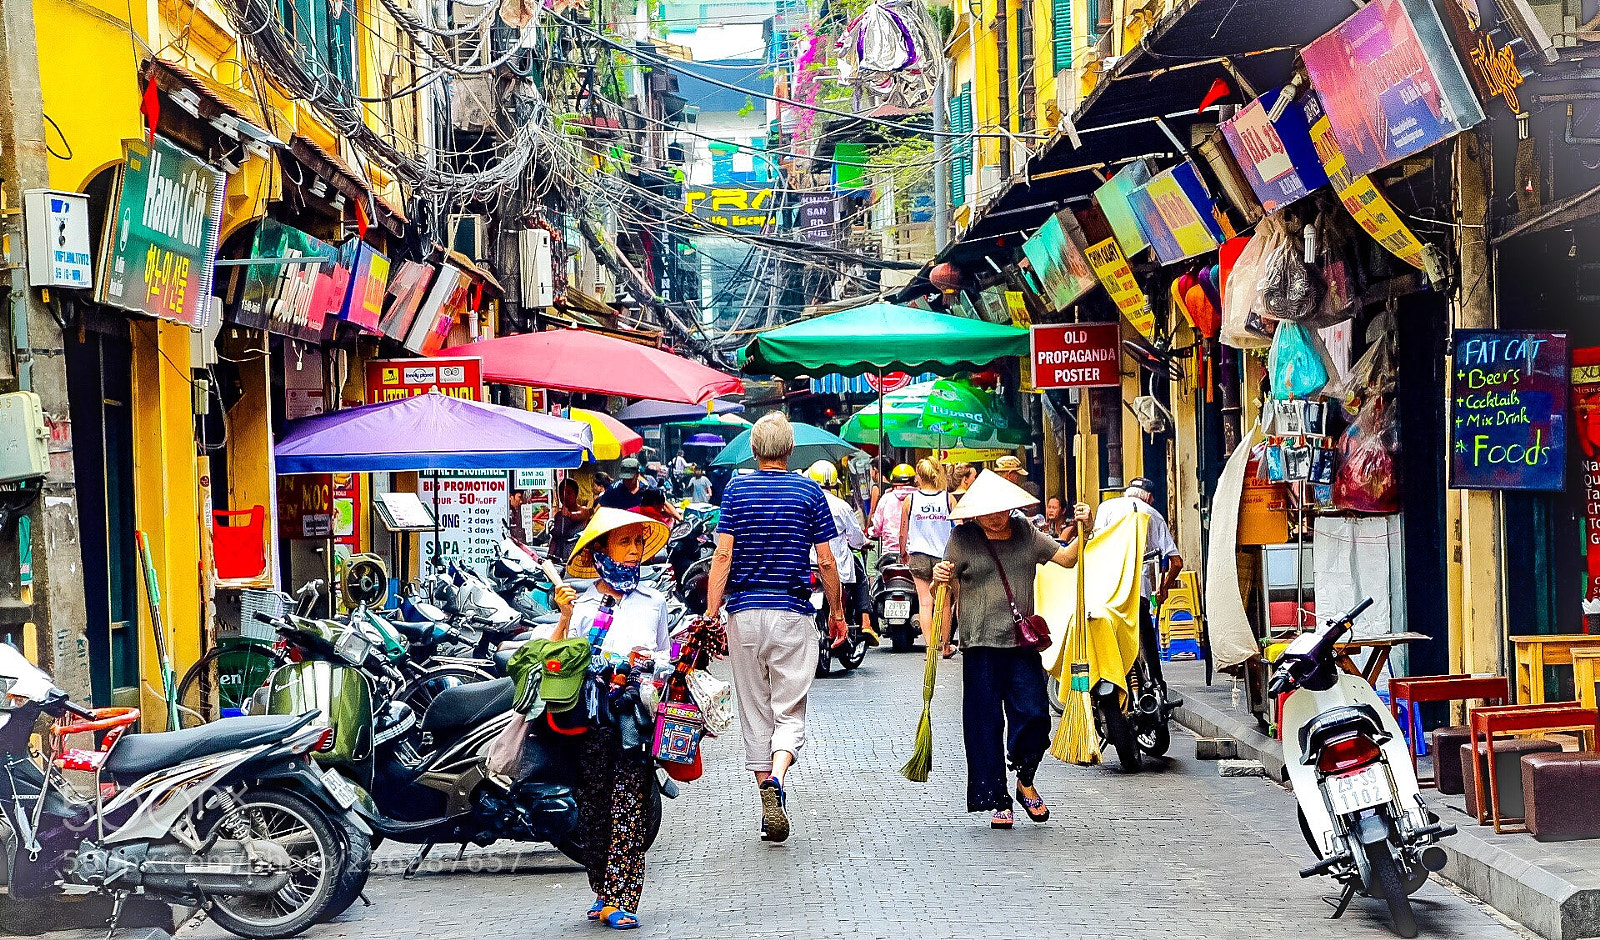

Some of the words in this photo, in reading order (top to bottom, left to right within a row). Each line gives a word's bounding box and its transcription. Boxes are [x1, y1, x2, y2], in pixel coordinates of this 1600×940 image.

[142, 149, 184, 239] Hanoi
[807, 207, 827, 216] SAN
[1064, 331, 1087, 343] OLD
[1038, 348, 1116, 365] PROPAGANDA
[1465, 339, 1501, 366] FAT
[1504, 339, 1547, 361] CAT
[1054, 368, 1100, 383] POSTER
[1468, 368, 1521, 389] Beers
[1465, 389, 1521, 409] Cocktails
[1466, 413, 1493, 427] Mix
[1496, 406, 1531, 426] Drink
[1474, 429, 1551, 466] Foods
[423, 481, 441, 492] BIG
[444, 480, 505, 492] PROMOTION
[518, 478, 547, 487] LAUNDRY
[1340, 785, 1383, 810] 1102
